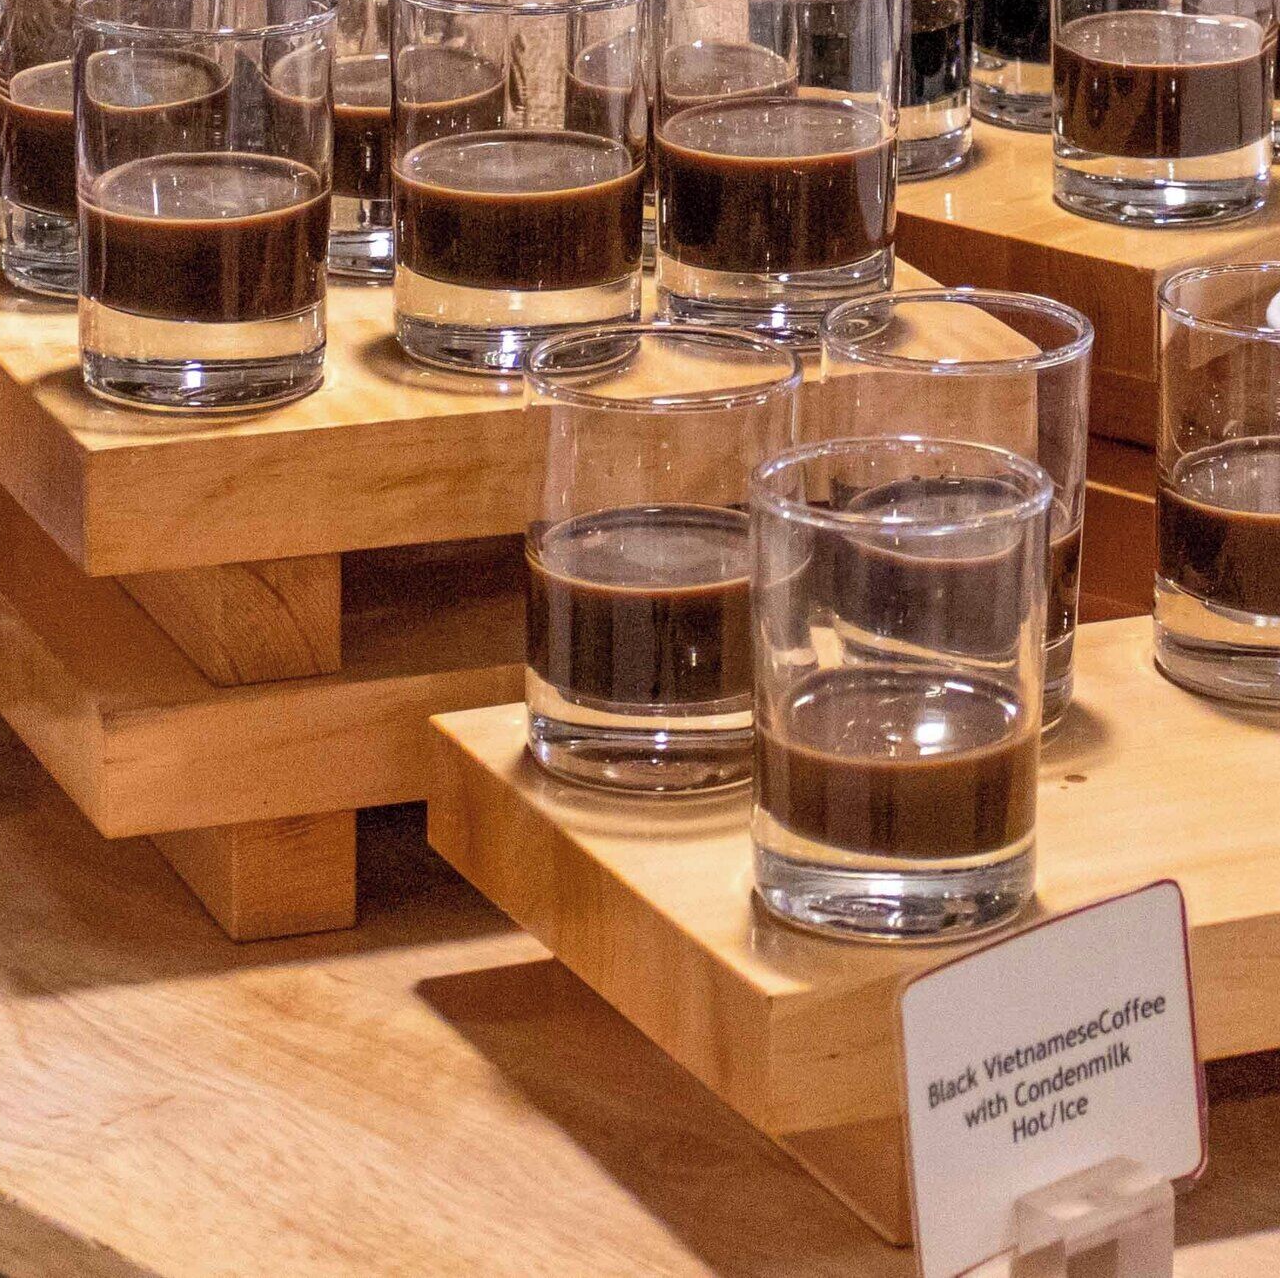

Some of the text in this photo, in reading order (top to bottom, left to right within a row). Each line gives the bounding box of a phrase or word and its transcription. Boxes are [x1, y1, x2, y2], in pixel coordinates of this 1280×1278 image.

[927, 992, 1167, 1110] Black VietnameseCoffee
[962, 1041, 1133, 1129] with Condenmilk
[1011, 1095, 1089, 1144] Hot/Ice
